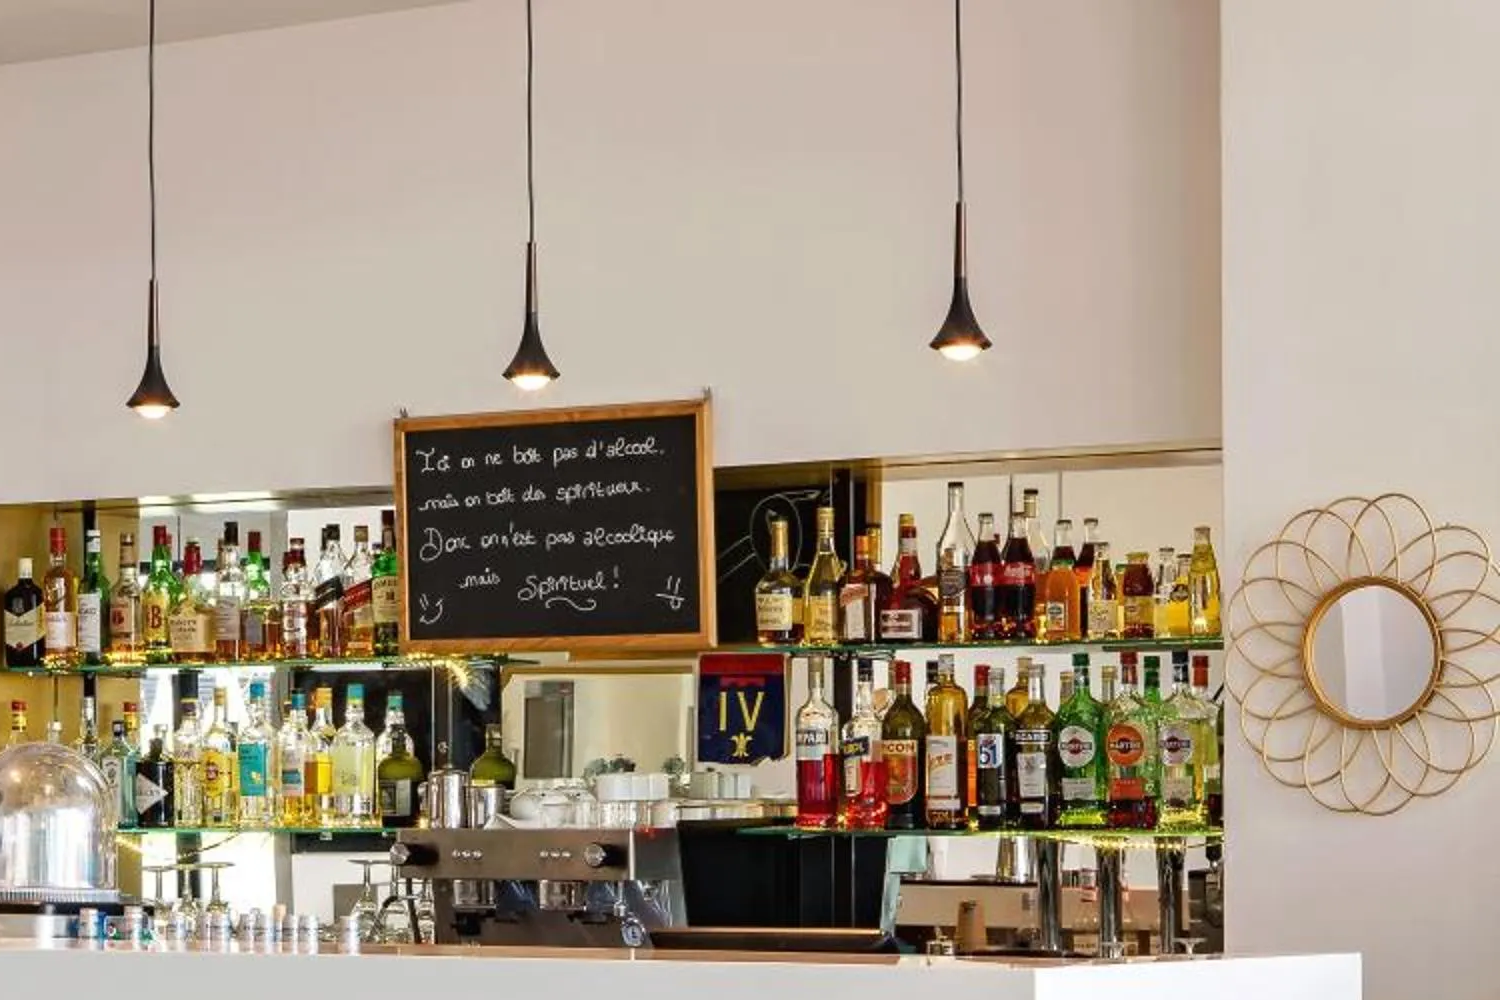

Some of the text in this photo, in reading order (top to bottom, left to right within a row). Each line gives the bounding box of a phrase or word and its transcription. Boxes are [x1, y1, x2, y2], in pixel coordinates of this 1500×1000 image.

[461, 456, 476, 469] on
[485, 452, 502, 465] ne
[553, 447, 579, 468] pas
[418, 493, 459, 511] mais
[464, 495, 481, 507] on
[419, 527, 471, 562] Donc
[545, 531, 576, 552] pas
[583, 523, 675, 549] alcoolique
[459, 567, 501, 589] mais
[719, 690, 765, 732] IV
